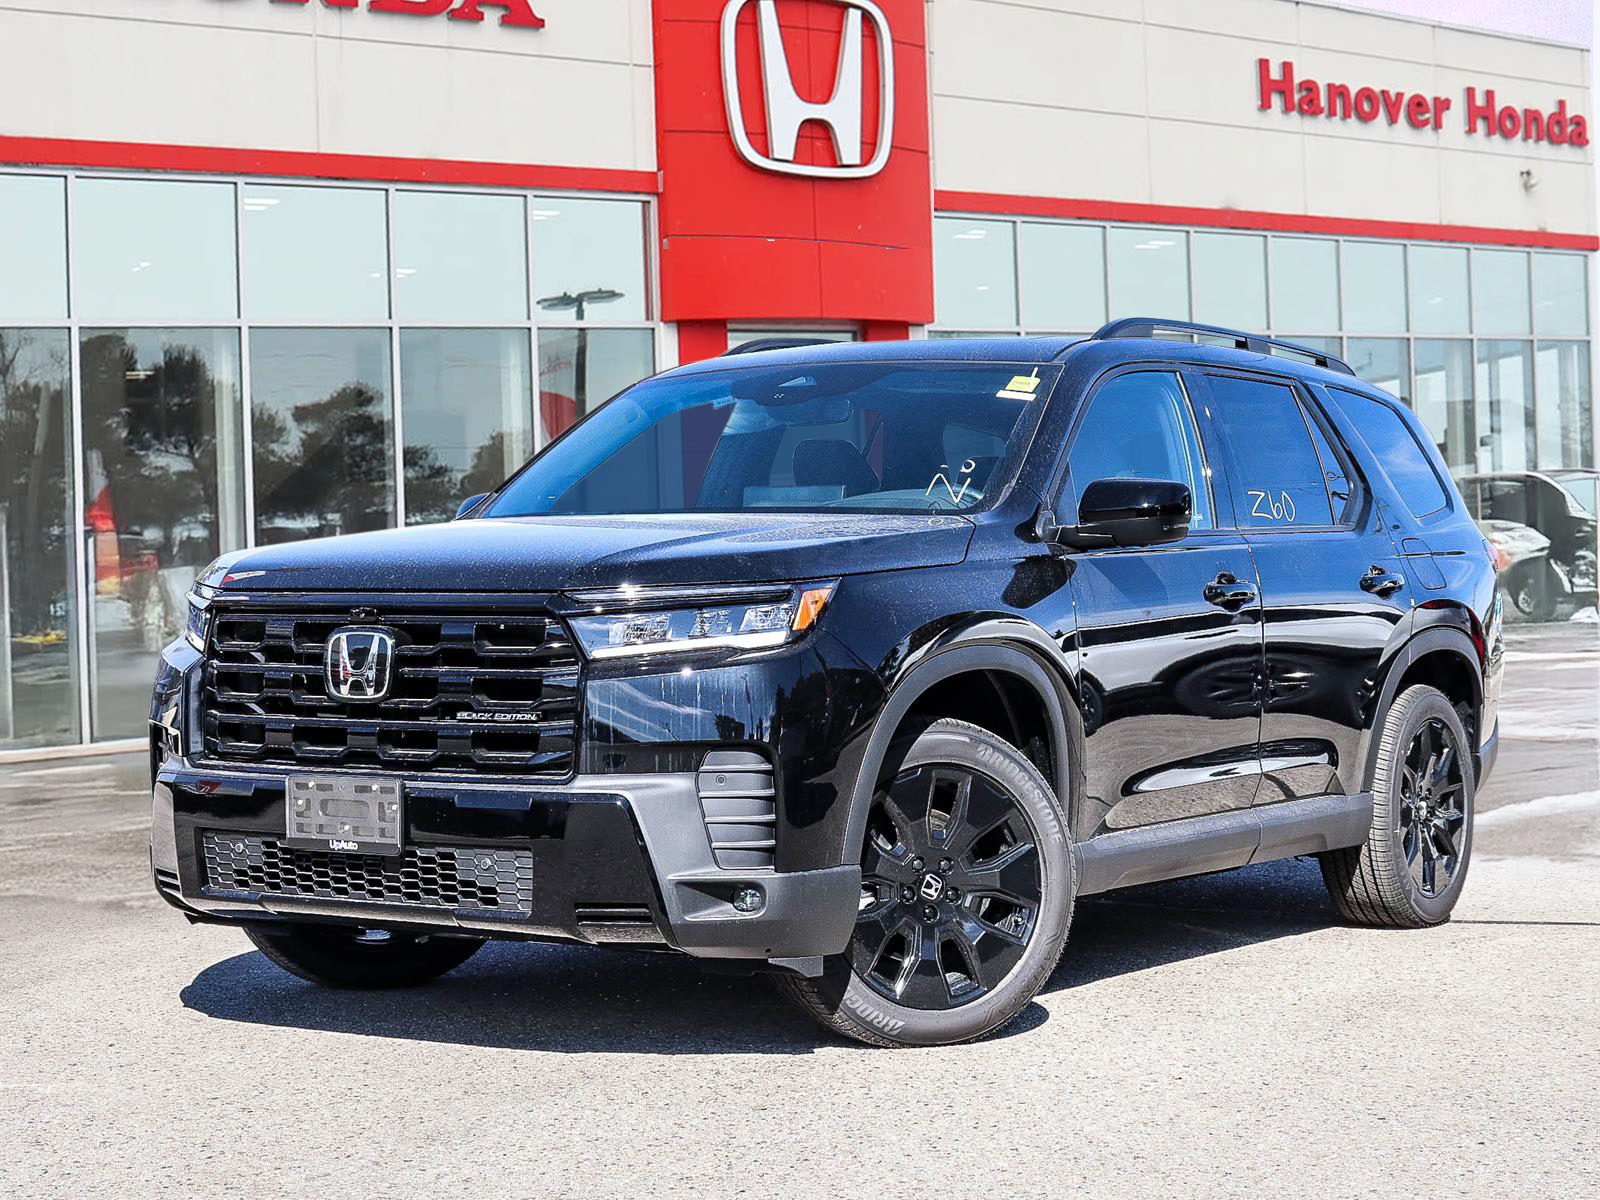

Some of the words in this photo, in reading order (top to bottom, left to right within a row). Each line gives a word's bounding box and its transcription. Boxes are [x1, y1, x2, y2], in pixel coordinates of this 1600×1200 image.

[1257, 58, 1451, 130] Hanover
[1465, 86, 1590, 147] Honda
[1247, 490, 1296, 522] Z60
[456, 711, 493, 720] BLACK
[976, 744, 1063, 844] BRIDGESTONE
[329, 839, 358, 851] UpAuto
